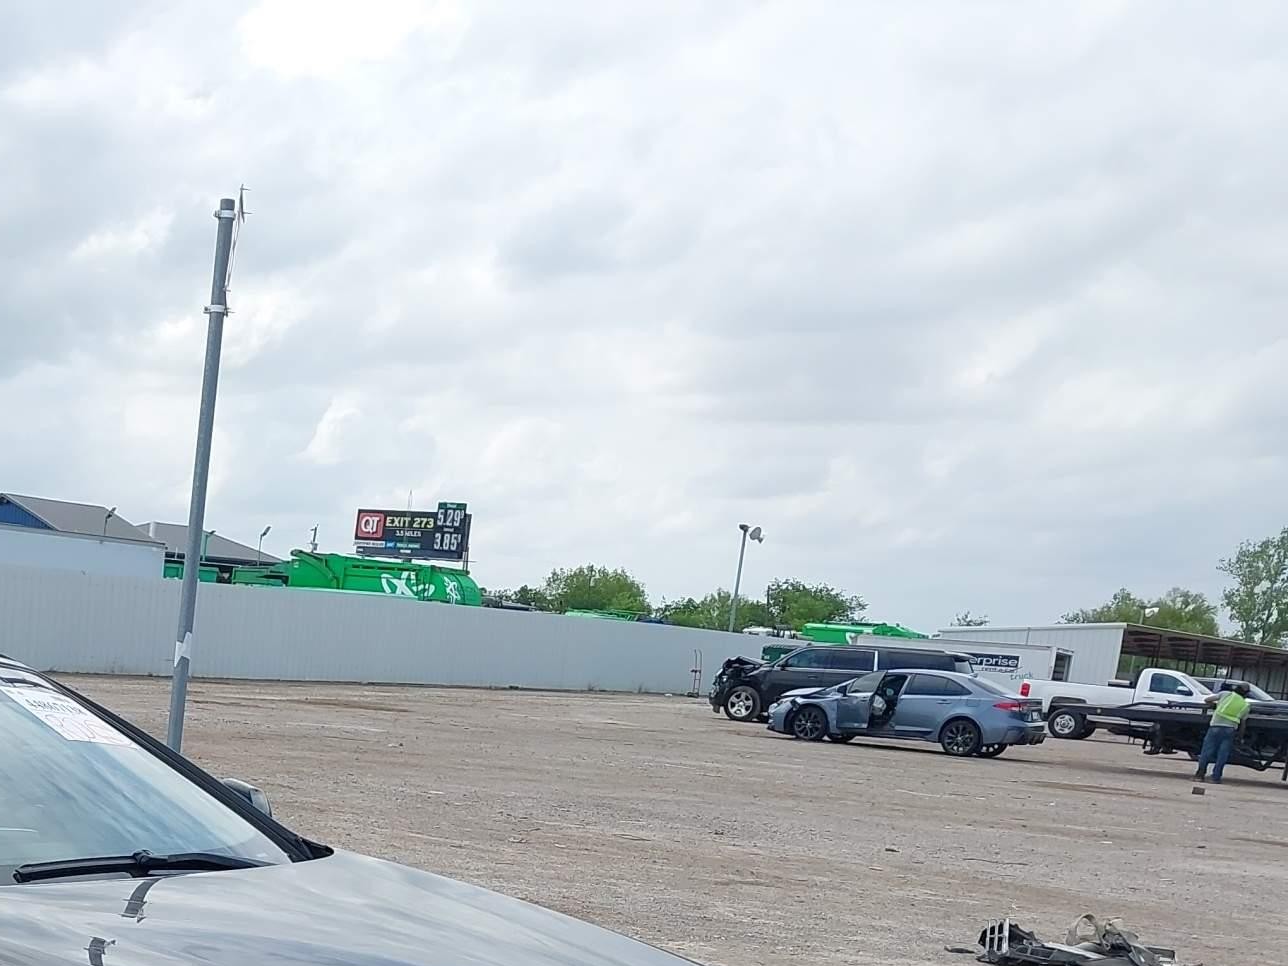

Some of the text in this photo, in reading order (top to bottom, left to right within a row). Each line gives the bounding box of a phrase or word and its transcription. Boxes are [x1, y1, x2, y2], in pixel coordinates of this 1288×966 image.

[360, 516, 380, 534] QT
[385, 516, 434, 528] EXIT 273
[1010, 671, 1033, 681] truck
